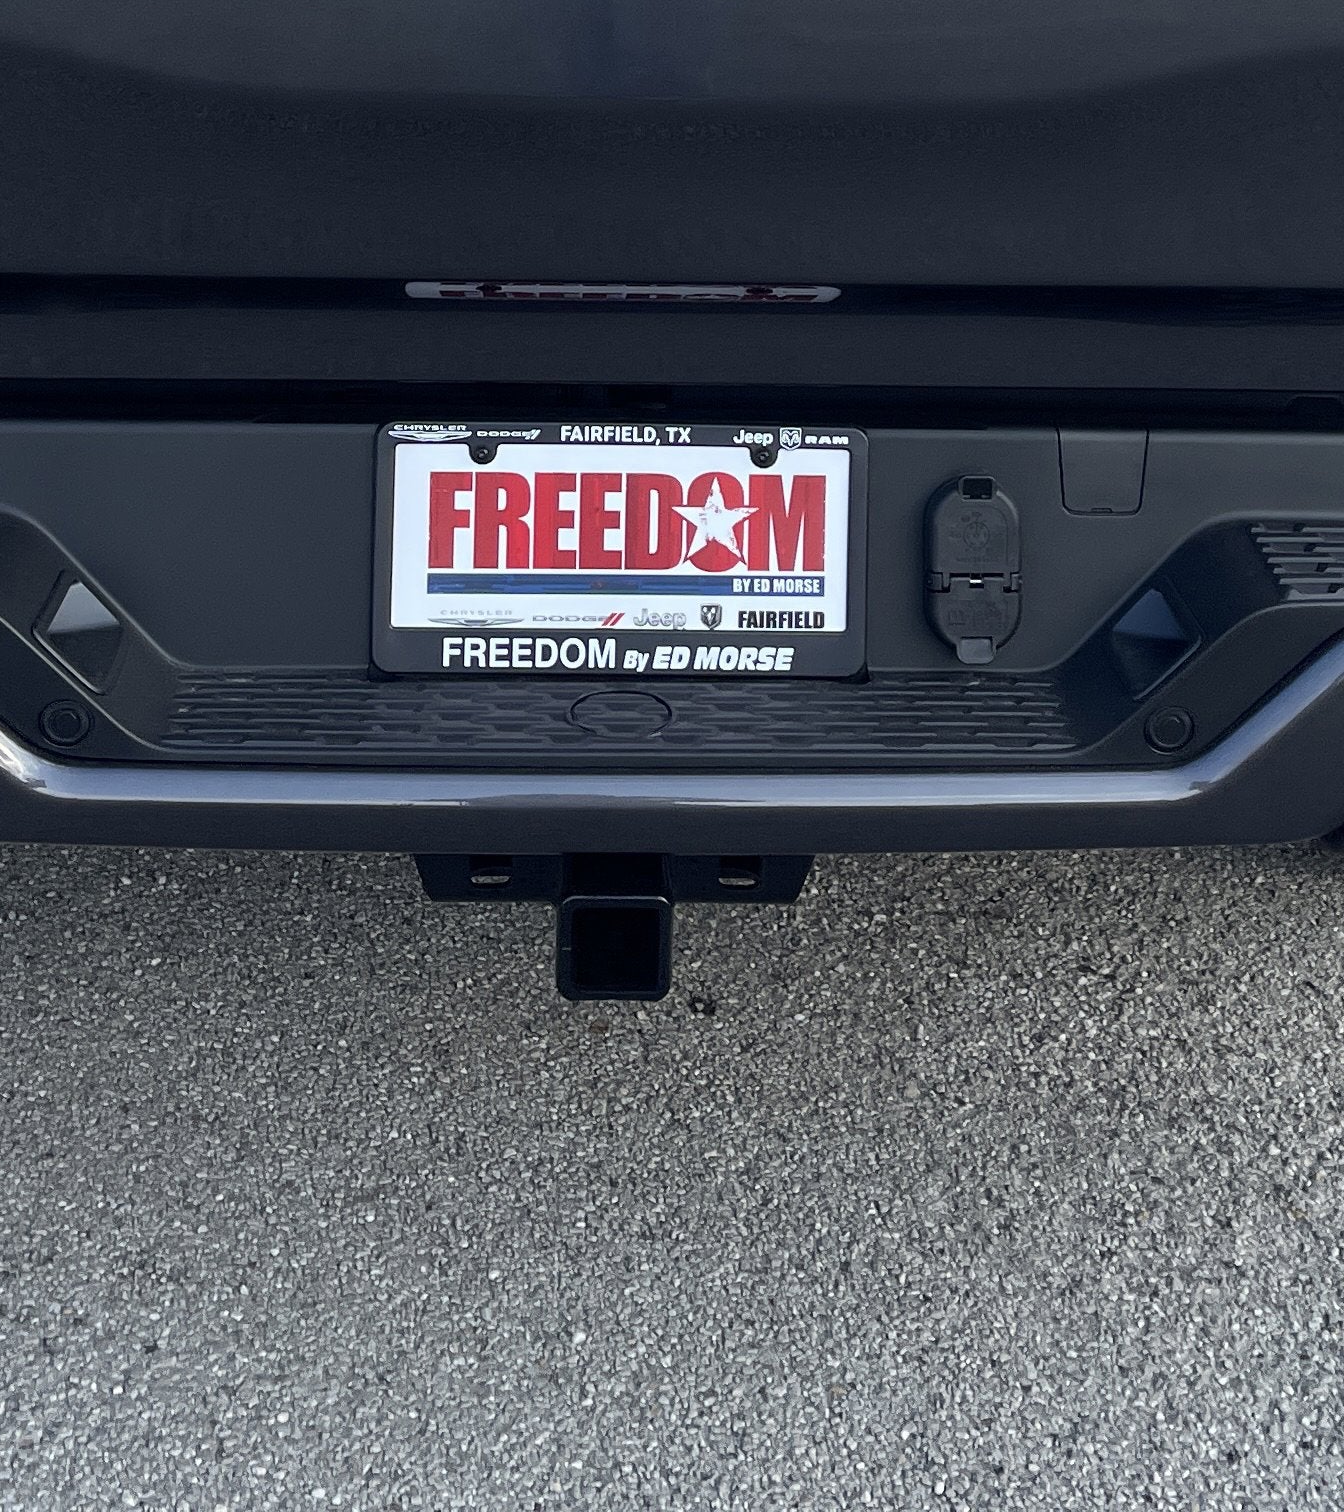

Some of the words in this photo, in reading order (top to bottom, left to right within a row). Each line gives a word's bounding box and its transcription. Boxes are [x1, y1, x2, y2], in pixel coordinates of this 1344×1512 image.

[560, 425, 661, 446] FAIRFIELD,
[665, 426, 692, 444] TX
[733, 429, 774, 447] Jeep
[804, 435, 849, 445] RAM
[427, 470, 827, 573] FREEDOM
[732, 578, 751, 593] BY
[753, 578, 770, 593] ED
[772, 579, 821, 594] MORSE
[632, 608, 687, 630] Jeep
[737, 610, 825, 629] FAIRFIELD
[442, 636, 617, 669] FREEDOM
[622, 648, 650, 673] By
[652, 645, 691, 670] ED
[693, 645, 795, 671] MORSE
